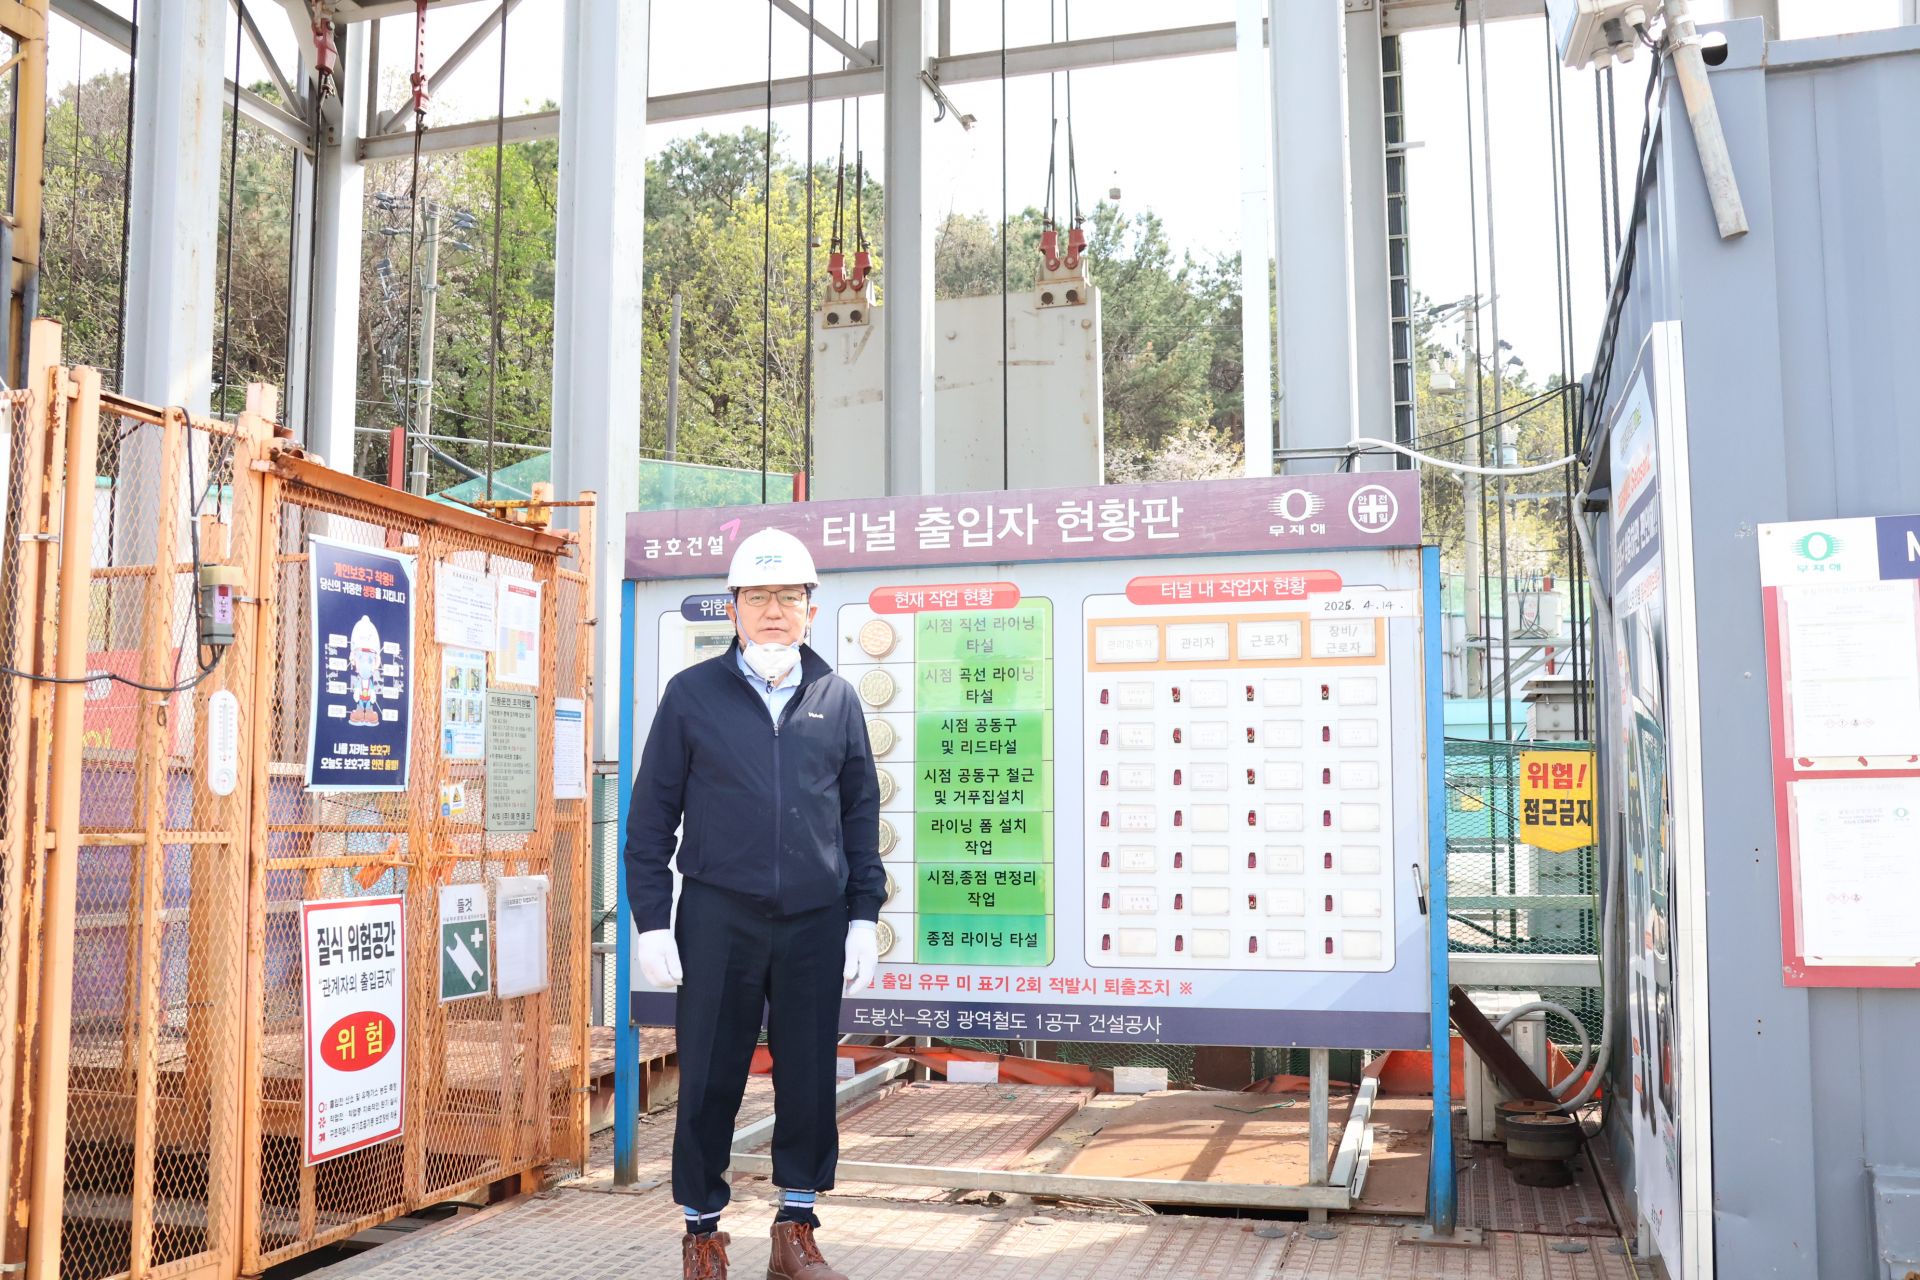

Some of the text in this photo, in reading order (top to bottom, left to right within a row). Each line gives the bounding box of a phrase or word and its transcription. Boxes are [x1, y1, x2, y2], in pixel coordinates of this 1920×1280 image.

[822, 496, 1184, 554] 터널 출입자 현황판
[643, 536, 723, 559] 금호건설
[320, 577, 341, 592] 당신의
[1161, 576, 1308, 599] 터널 내 작업자 현황
[895, 589, 994, 608] 현재 작업 현황
[700, 599, 735, 616] 위험
[926, 616, 1035, 633] 시점 직선 라이닝
[966, 638, 994, 653] 타설
[1181, 636, 1215, 650] 관리자
[1250, 634, 1289, 648] 근로자
[1327, 642, 1361, 654] 근로자
[925, 666, 1035, 683] 시점 곡선 라이닝
[966, 689, 993, 704] 타설
[941, 717, 1017, 733] 시점 공동구
[941, 739, 1017, 755] 및 리드타설
[924, 768, 1035, 784] 시점 공동구 철근
[1528, 762, 1587, 789] 위험!
[934, 789, 1024, 805] 및 거푸집설치
[1524, 799, 1591, 826] 접근금지
[931, 818, 1027, 834] 라이닝 폼 설치
[964, 840, 993, 856] 작업
[927, 869, 1036, 886] 시점,종점 면정리
[967, 892, 996, 908] 작업
[317, 920, 396, 966] 질식 위험공간
[926, 931, 1038, 948] 종점 라이닝 타설
[882, 973, 912, 989] 출입
[919, 974, 950, 991] 유무
[957, 975, 971, 991] 미
[978, 976, 1009, 992] 표기
[1016, 977, 1041, 993] 2회
[1049, 977, 1097, 995] 적발시
[1104, 978, 1170, 996] 퇴출조치
[957, 1010, 1027, 1031] 광역철도
[1036, 1013, 1081, 1033] 1공구
[1089, 1014, 1162, 1035] 건설공사
